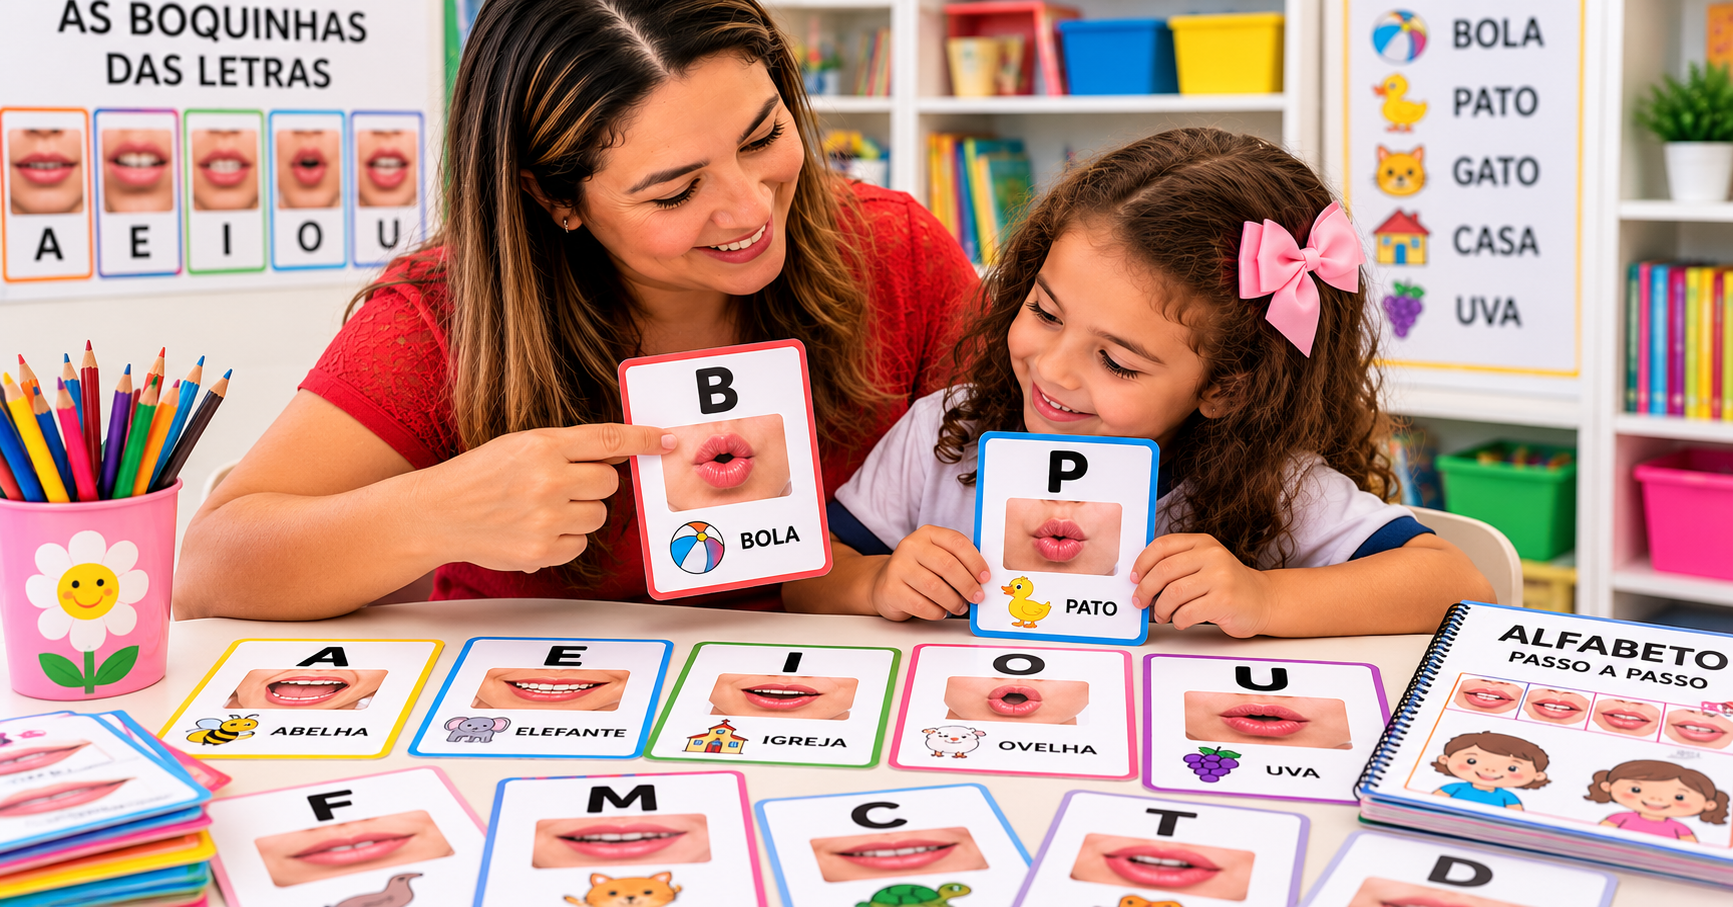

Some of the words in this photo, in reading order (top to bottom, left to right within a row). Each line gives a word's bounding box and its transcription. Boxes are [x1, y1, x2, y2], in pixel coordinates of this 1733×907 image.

[58, 0, 112, 35] AS
[130, 2, 367, 43] BOQUINHAS
[1454, 17, 1544, 49] BOLA
[107, 53, 183, 86] DAS
[199, 55, 331, 89] LETRAS
[1454, 86, 1538, 117] PATO
[1453, 156, 1539, 186] GATO
[35, 227, 63, 261] A
[130, 226, 150, 259] E
[222, 222, 231, 256] I
[298, 221, 322, 252] O
[378, 219, 399, 250] U
[1454, 226, 1539, 256] CASA
[1457, 298, 1521, 326] UVA
[696, 367, 737, 414] B
[1048, 451, 1088, 493] P
[741, 526, 800, 549] BOLA
[1066, 599, 1117, 616] PATO
[296, 647, 348, 666] A
[544, 646, 587, 666] E
[783, 652, 802, 672] I
[1498, 624, 1729, 671] ALFABETO
[993, 654, 1045, 675] O
[1236, 666, 1288, 691] U
[1508, 650, 1591, 673] PASSO
[1599, 665, 1616, 677] A
[1626, 667, 1709, 690] PASSO
[270, 727, 368, 736] ABELHA
[516, 727, 626, 737] ELEFANTE
[763, 736, 846, 747] IGREJA
[999, 741, 1097, 754] OVELHA
[1267, 766, 1320, 778] UVA
[308, 790, 352, 821] F
[588, 785, 657, 812] M
[852, 802, 907, 828] C
[1147, 809, 1197, 836] T
[1429, 856, 1492, 886] D
